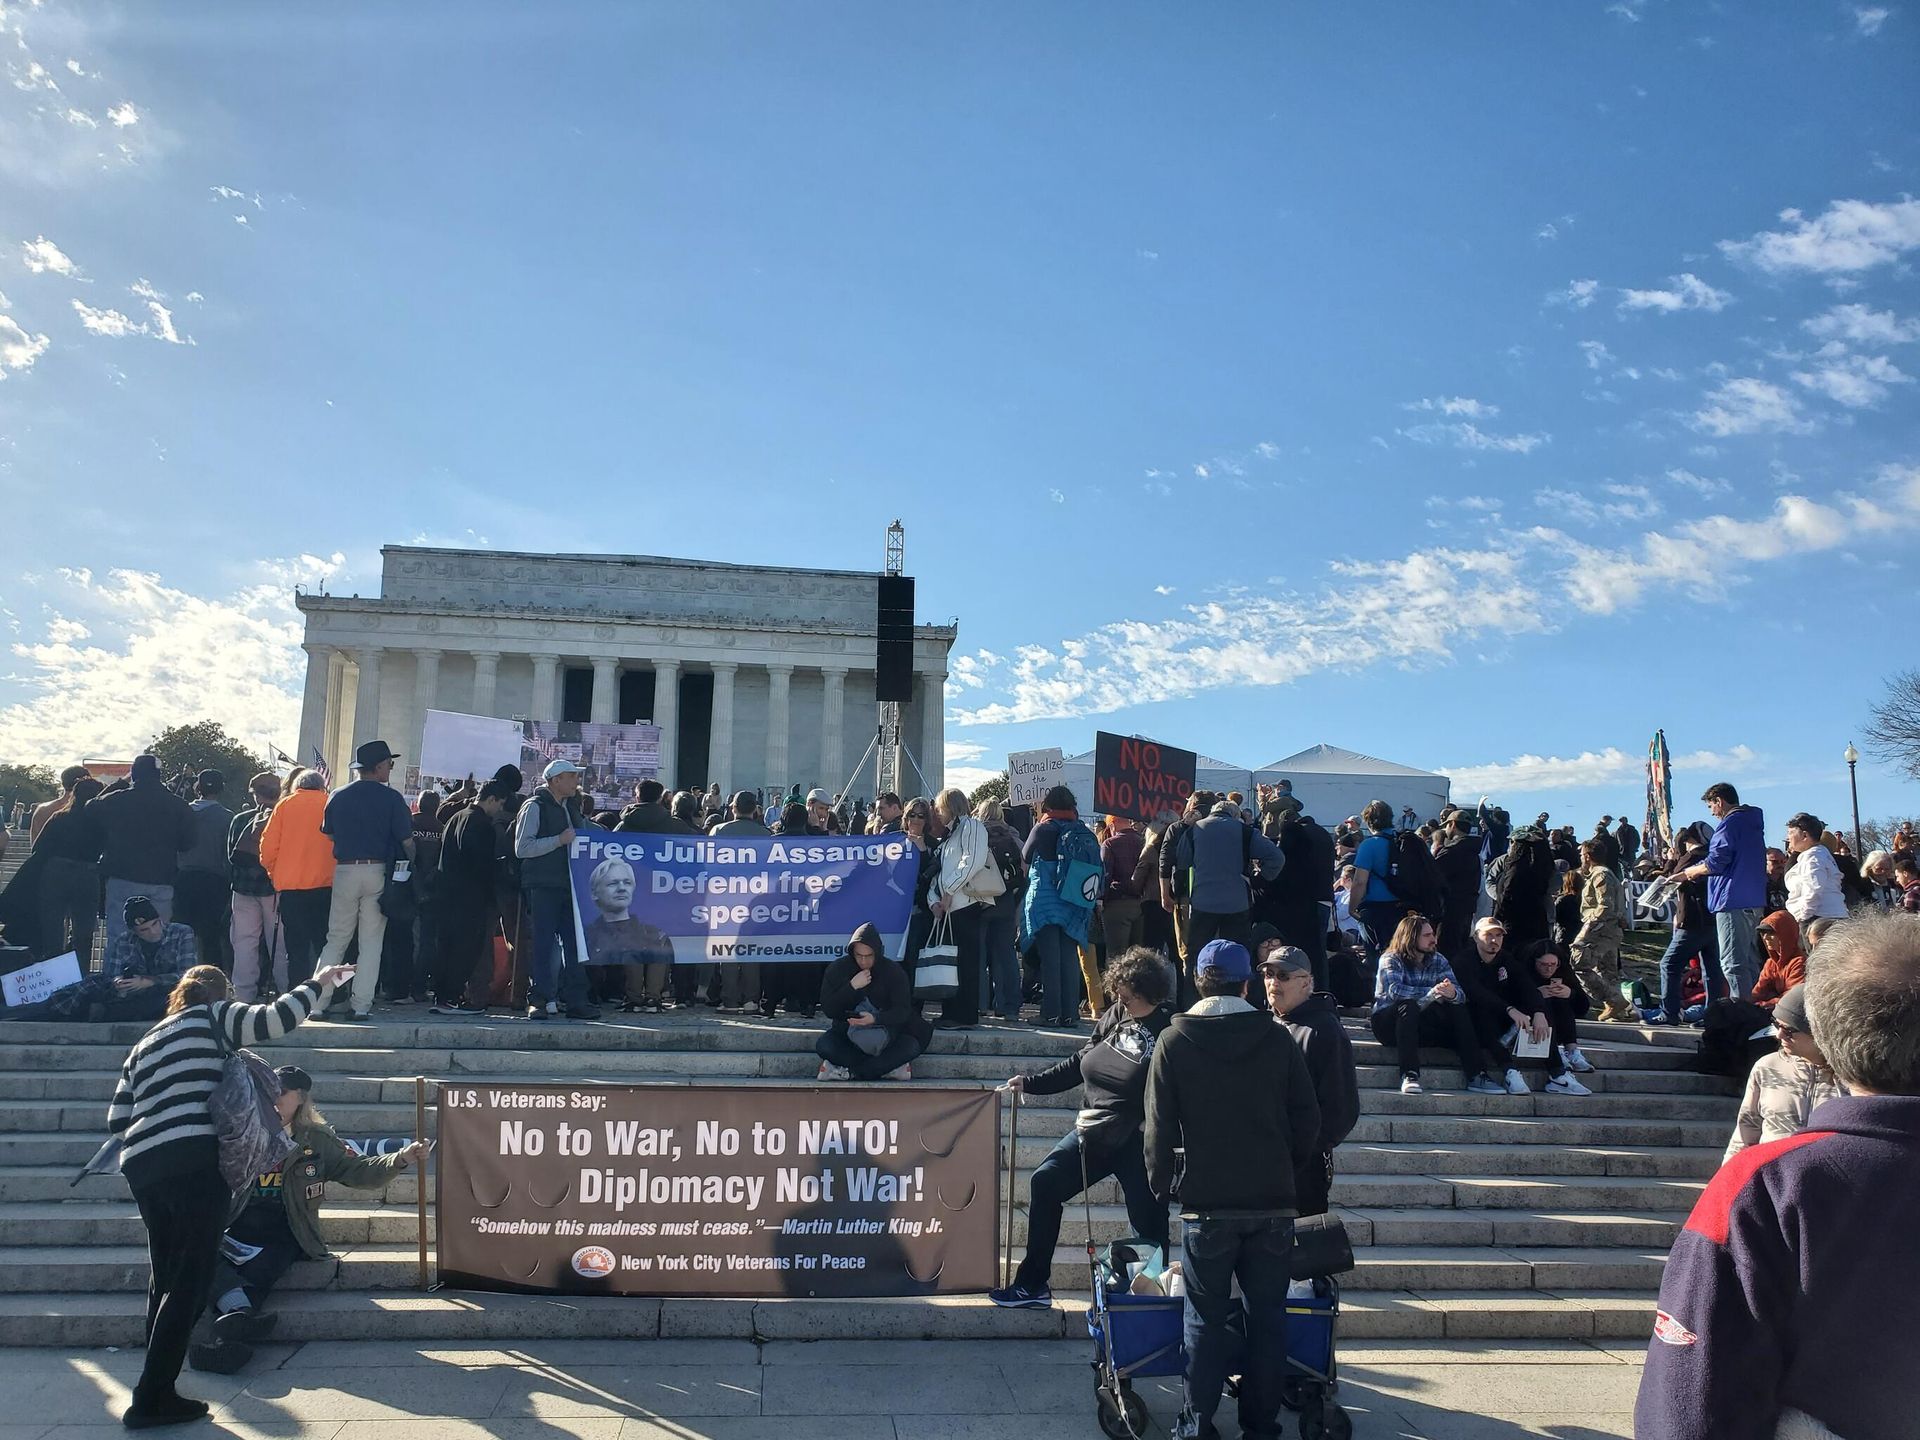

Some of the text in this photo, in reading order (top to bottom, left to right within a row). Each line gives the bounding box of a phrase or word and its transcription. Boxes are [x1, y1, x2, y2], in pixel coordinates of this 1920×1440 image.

[1010, 757, 1064, 776] Nationalize
[1119, 739, 1190, 797] NO NATO
[1031, 775, 1048, 784] the
[1013, 782, 1054, 802] Railro
[1097, 775, 1133, 810] NO
[426, 831, 441, 839] PAU
[570, 836, 913, 866] Free Julian Assange!
[651, 870, 843, 895] Defend free
[690, 898, 820, 930] speech!
[15, 970, 42, 984] WHO
[18, 978, 52, 994] OWNS
[447, 1090, 607, 1112] U.S. Veterans Say:
[500, 1120, 899, 1162] No to War, No to NATO!
[580, 1167, 924, 1212] Diplomacy Not War!
[554, 1219, 584, 1236] this
[587, 1219, 657, 1236] madness
[660, 1219, 699, 1236] must
[836, 1218, 885, 1235] Luther
[888, 1218, 922, 1238] King
[925, 1218, 943, 1234] Jr.
[621, 1254, 866, 1274] New York City Veterans For Peace
